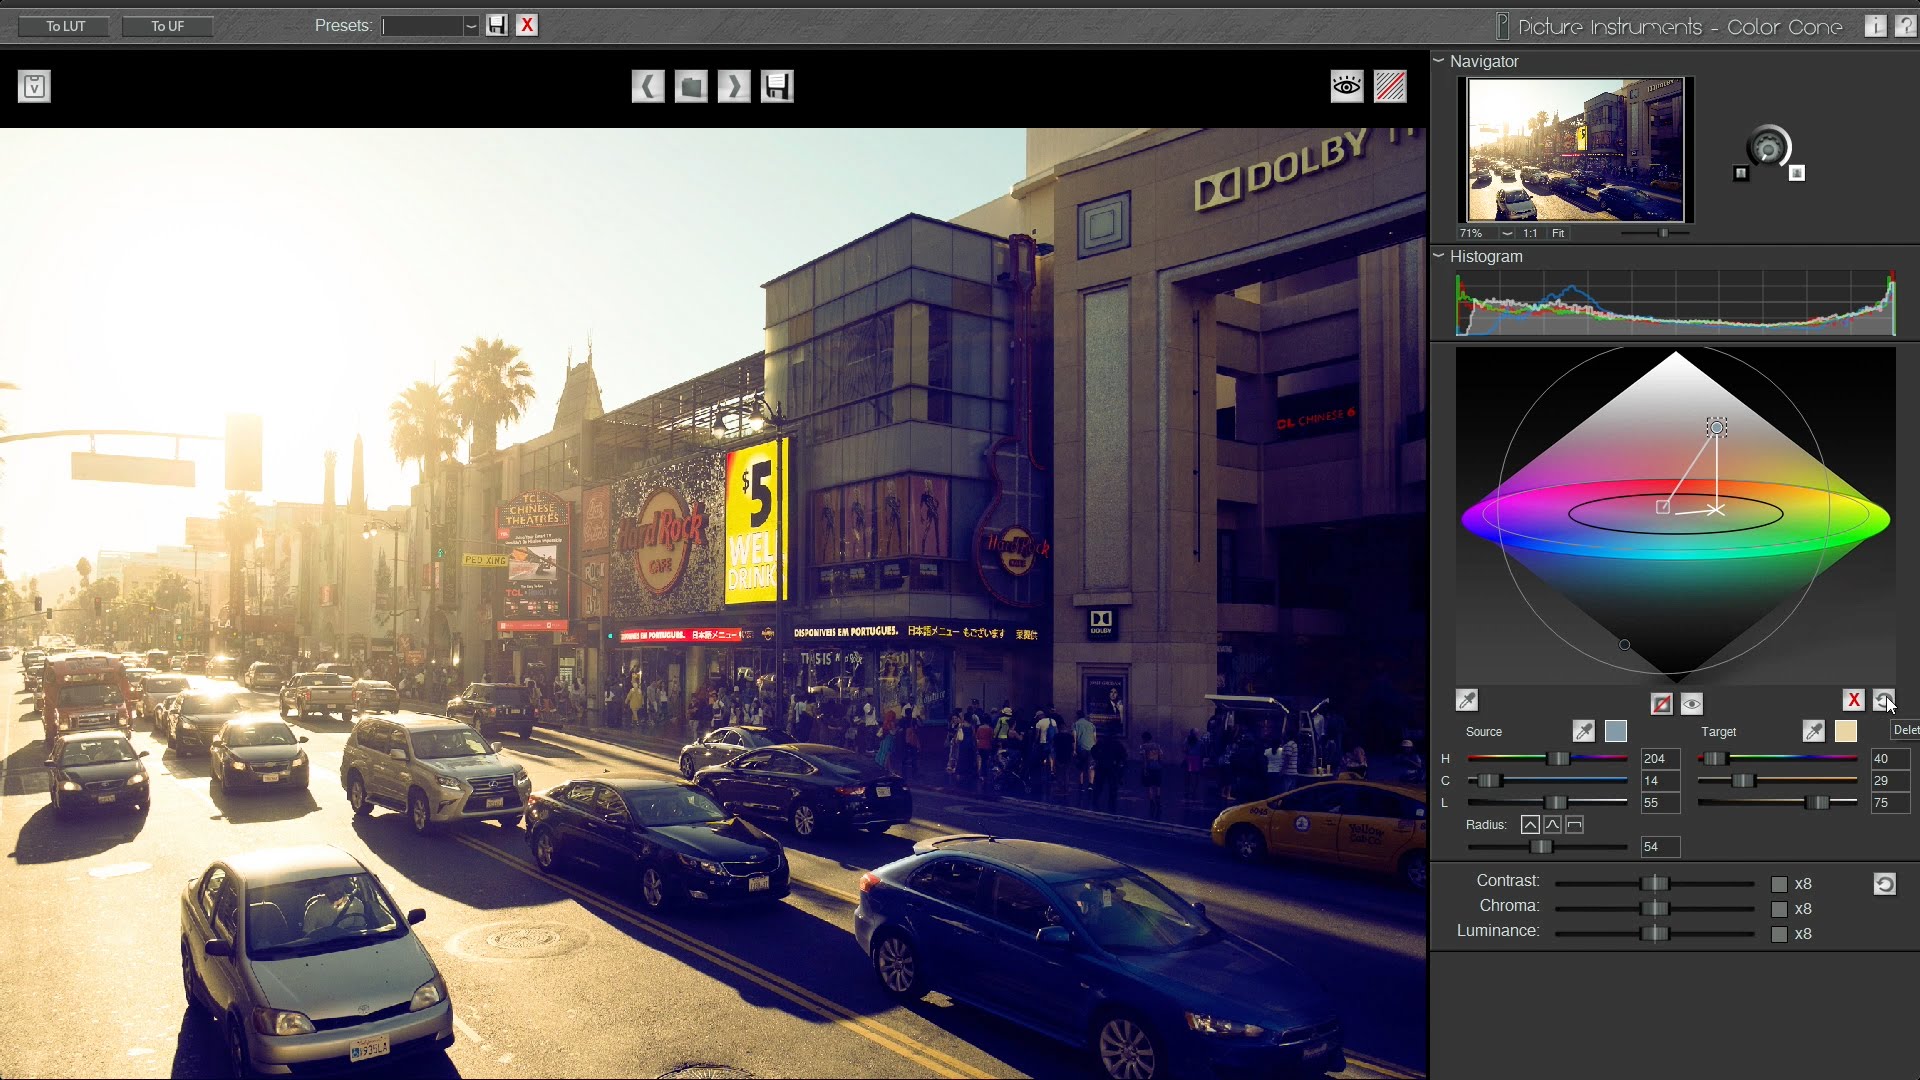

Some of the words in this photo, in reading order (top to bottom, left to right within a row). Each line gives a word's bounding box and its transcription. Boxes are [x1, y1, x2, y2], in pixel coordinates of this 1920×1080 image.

[46, 21, 60, 32] To
[63, 21, 86, 32] LUT
[152, 21, 165, 32] To
[169, 21, 184, 32] UF
[315, 19, 373, 32] Presets:
[1519, 17, 1584, 36] Picture
[1591, 17, 1703, 36] Instruments
[1727, 18, 1782, 36] Color
[1788, 18, 1844, 36] Cone
[1450, 54, 1520, 71] Navigator
[1248, 128, 1367, 192] DOLBY
[1460, 228, 1483, 238] 71%
[1523, 228, 1537, 238] 1:1
[1552, 228, 1565, 238] Fit
[1450, 249, 1523, 266] Histogram
[1298, 409, 1344, 426] CHINESE
[522, 493, 543, 503] TCL
[509, 503, 555, 515] CHINESE
[505, 512, 559, 526] THEATRES
[659, 502, 703, 550] Rock
[465, 556, 483, 564] PED
[486, 556, 506, 565] XING
[649, 558, 673, 575] CAFE
[729, 564, 785, 592] DRINK
[837, 628, 849, 637] EM
[1465, 726, 1503, 737] Source
[1700, 726, 1737, 740] Target
[1894, 724, 1920, 735] Delet
[1441, 753, 1450, 764] H
[1643, 753, 1666, 764] 204
[1873, 753, 1889, 764] 40
[1441, 775, 1451, 786] C
[1644, 775, 1659, 786] 14
[1873, 775, 1889, 786] 29
[1441, 797, 1449, 808] L
[1643, 797, 1659, 808] 55
[1873, 797, 1889, 808] 75
[1466, 819, 1508, 830] Radius:
[1348, 824, 1385, 837] Yellow
[1643, 841, 1659, 852] 54
[1476, 873, 1540, 887] Contrast:
[1794, 877, 1813, 890] x8
[1479, 898, 1540, 912] Chroma:
[1794, 902, 1813, 915] x8
[1457, 923, 1540, 937] Luminance:
[1794, 927, 1813, 940] x8
